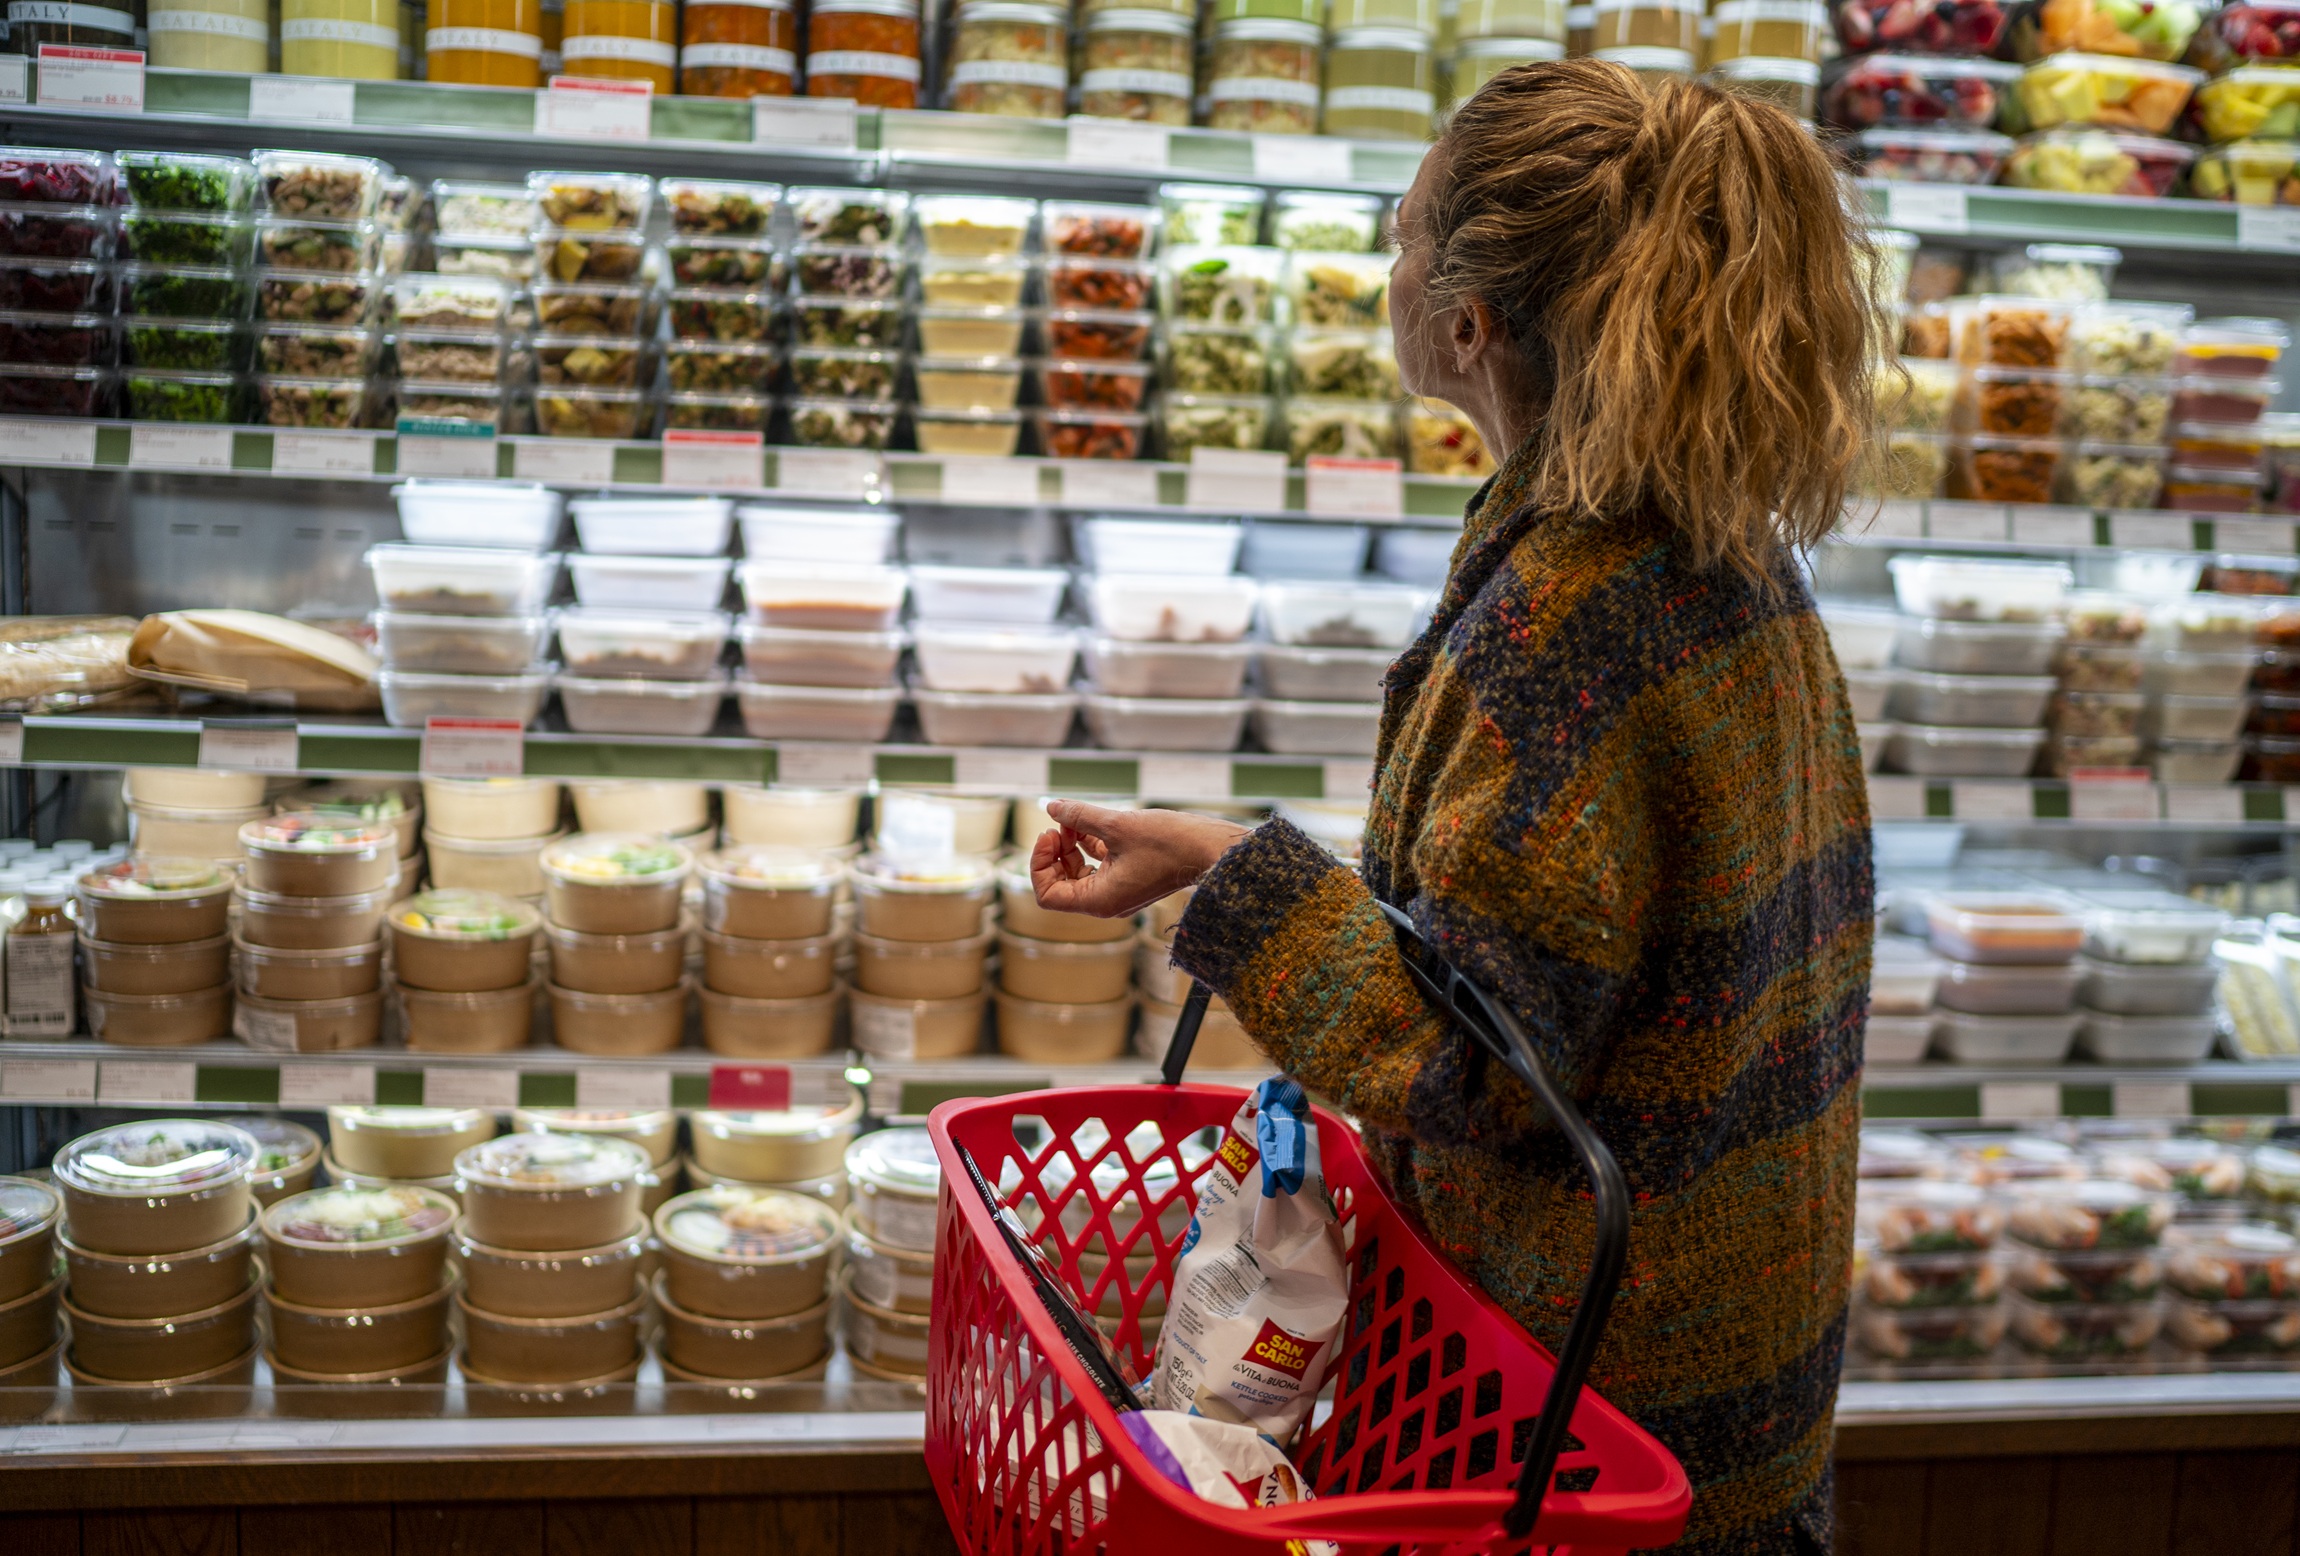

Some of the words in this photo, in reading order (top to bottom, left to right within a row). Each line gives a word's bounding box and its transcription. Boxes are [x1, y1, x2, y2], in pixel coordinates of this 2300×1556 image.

[1219, 1143, 1248, 1174] ARLO
[1224, 1135, 1250, 1161] SAN
[1213, 1170, 1239, 1198] BUONA
[1255, 1342, 1306, 1370] CARLO
[1269, 1334, 1304, 1357] SAN
[1064, 1337, 1079, 1358] DARK
[1077, 1354, 1106, 1389] CHOCOLATE
[1241, 1364, 1262, 1382] VITA
[1266, 1377, 1300, 1391] BUONA
[1231, 1380, 1258, 1396] KETTLE
[1257, 1391, 1288, 1403] COOKED
[1238, 1393, 1258, 1403] potato
